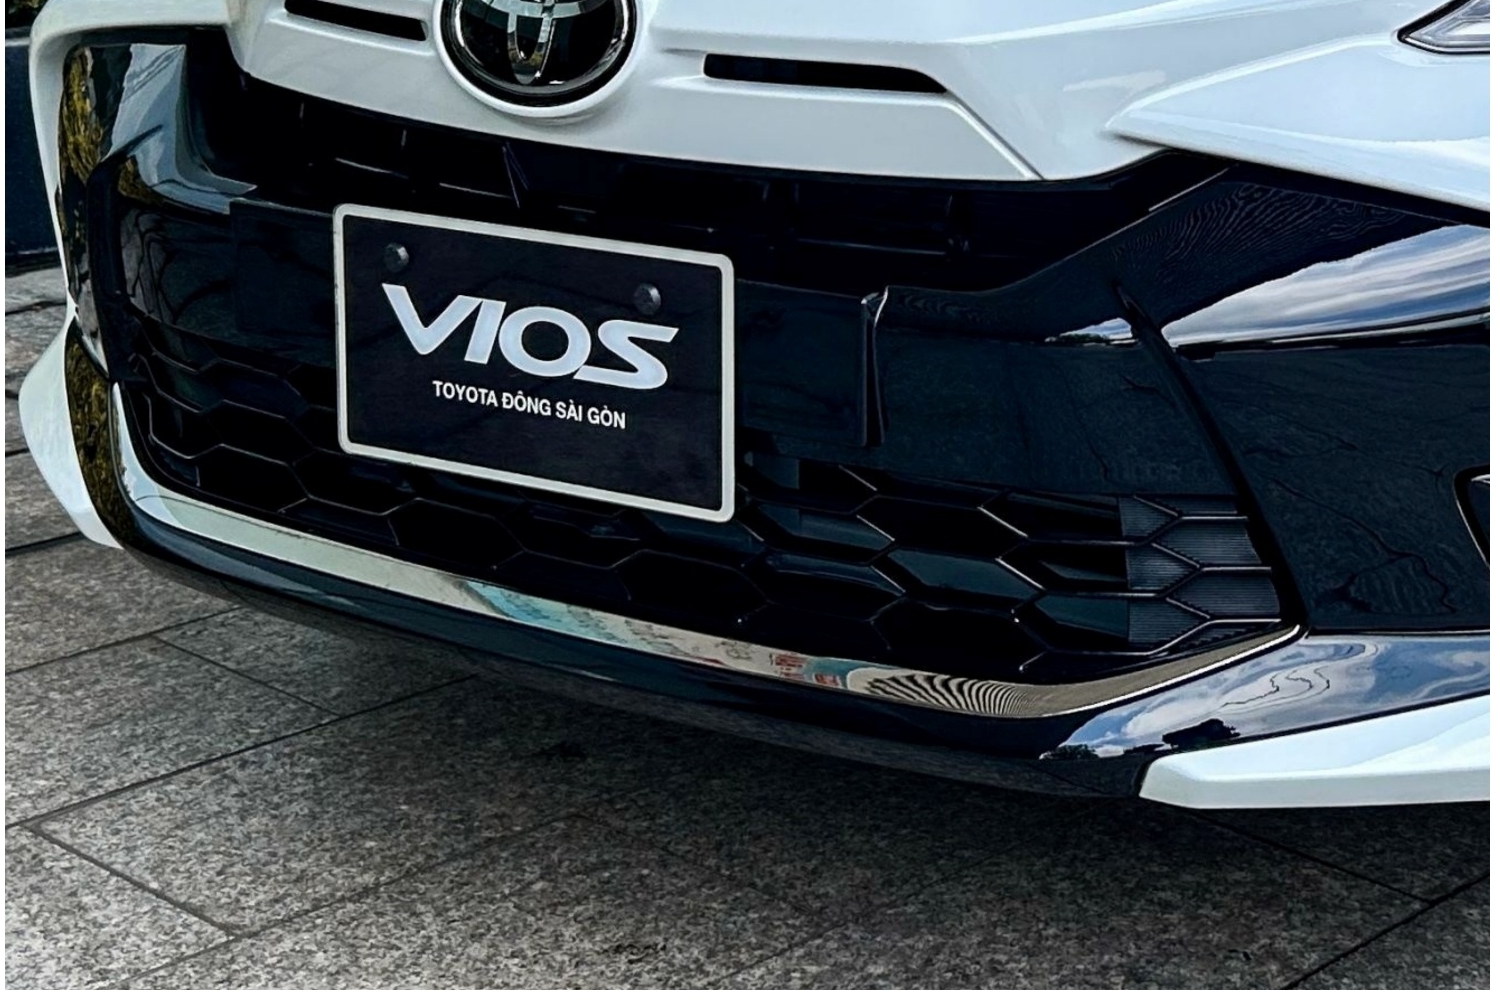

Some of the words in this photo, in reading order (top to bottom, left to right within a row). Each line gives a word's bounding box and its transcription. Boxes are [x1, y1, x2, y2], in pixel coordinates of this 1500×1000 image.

[382, 283, 679, 389] VIOS
[432, 380, 498, 408] TOYOTA
[502, 390, 551, 417] ĐÔNG
[555, 400, 583, 423] SÀI
[587, 405, 626, 429] GÒN
